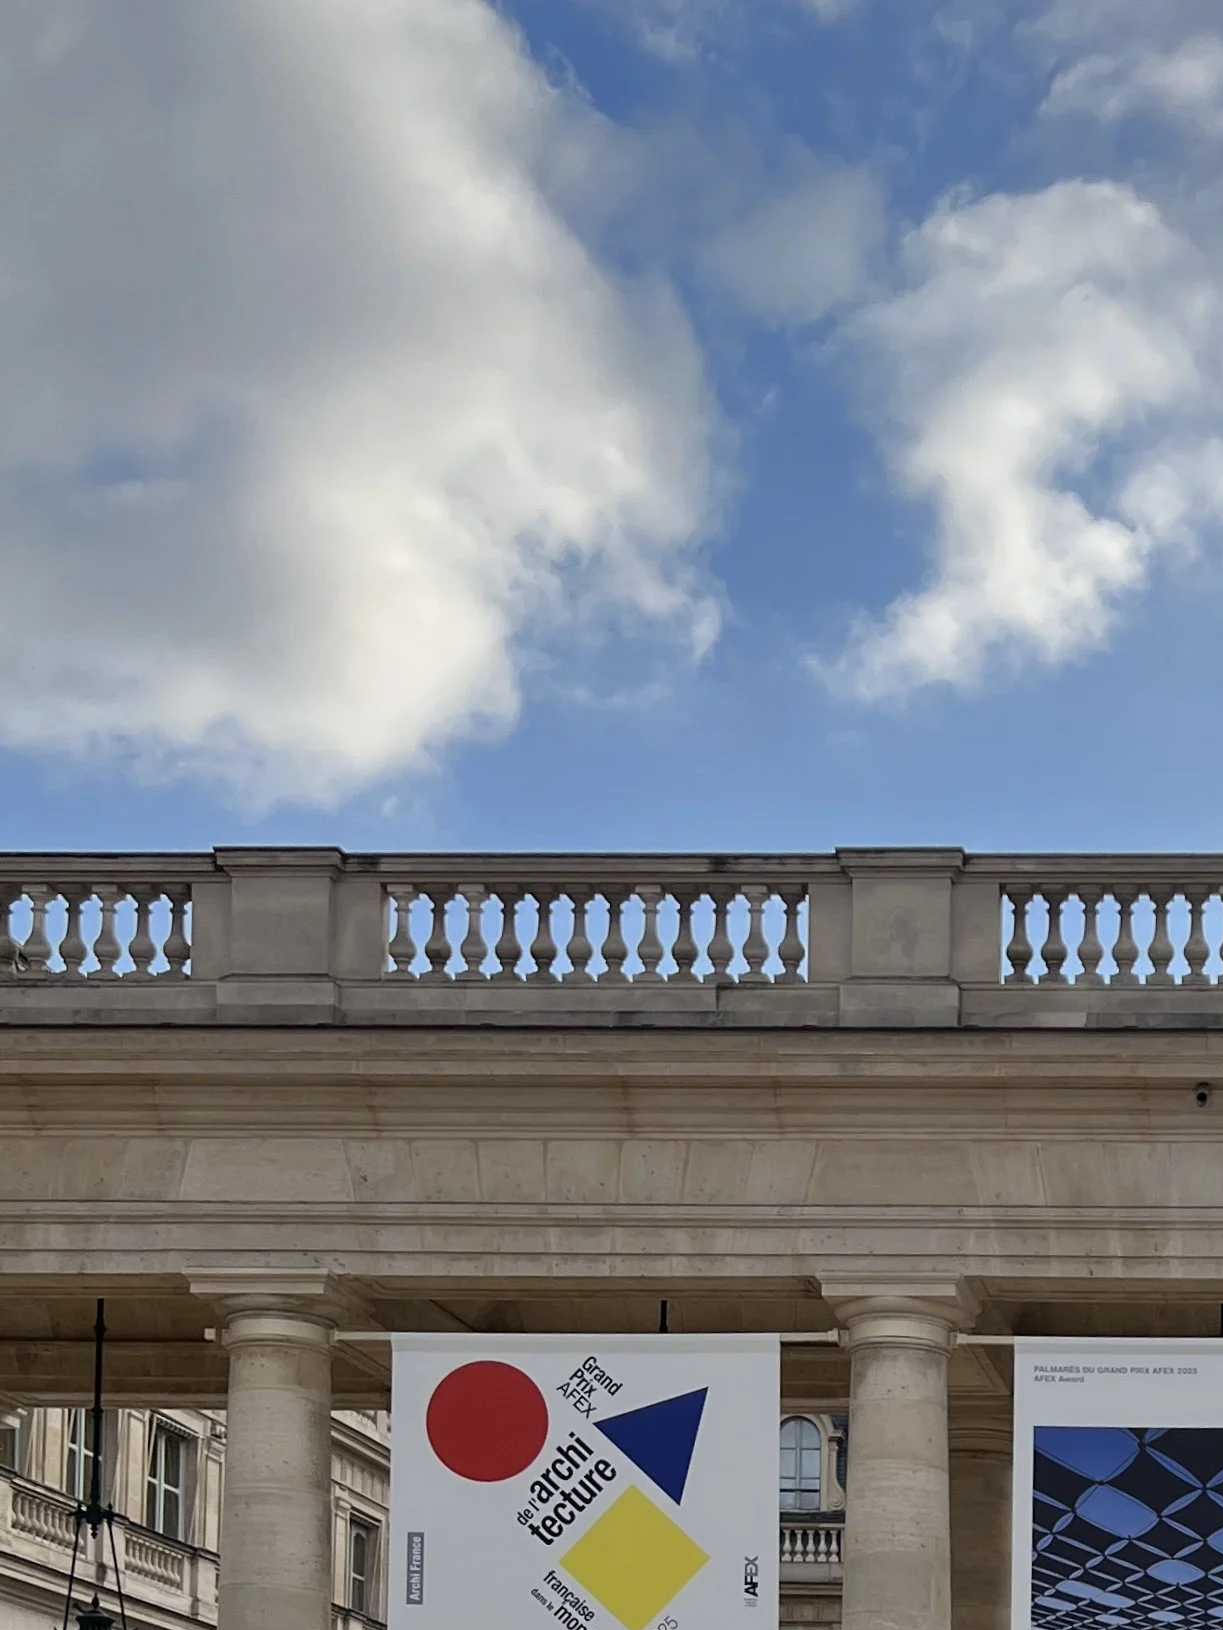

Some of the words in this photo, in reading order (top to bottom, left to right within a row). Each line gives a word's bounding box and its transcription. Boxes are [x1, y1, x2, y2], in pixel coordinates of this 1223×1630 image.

[569, 1368, 597, 1398] Prix
[582, 1356, 623, 1396] Grand
[1083, 1366, 1095, 1374] DU
[1152, 1367, 1174, 1375] AFEX
[556, 1382, 597, 1419] AFEX
[517, 1508, 534, 1525] de
[528, 1459, 617, 1546] tecture
[410, 1536, 422, 1571] France
[409, 1573, 420, 1601] Archi
[744, 1556, 758, 1597] AFEX
[530, 1588, 549, 1606] dans
[543, 1570, 595, 1622] française
